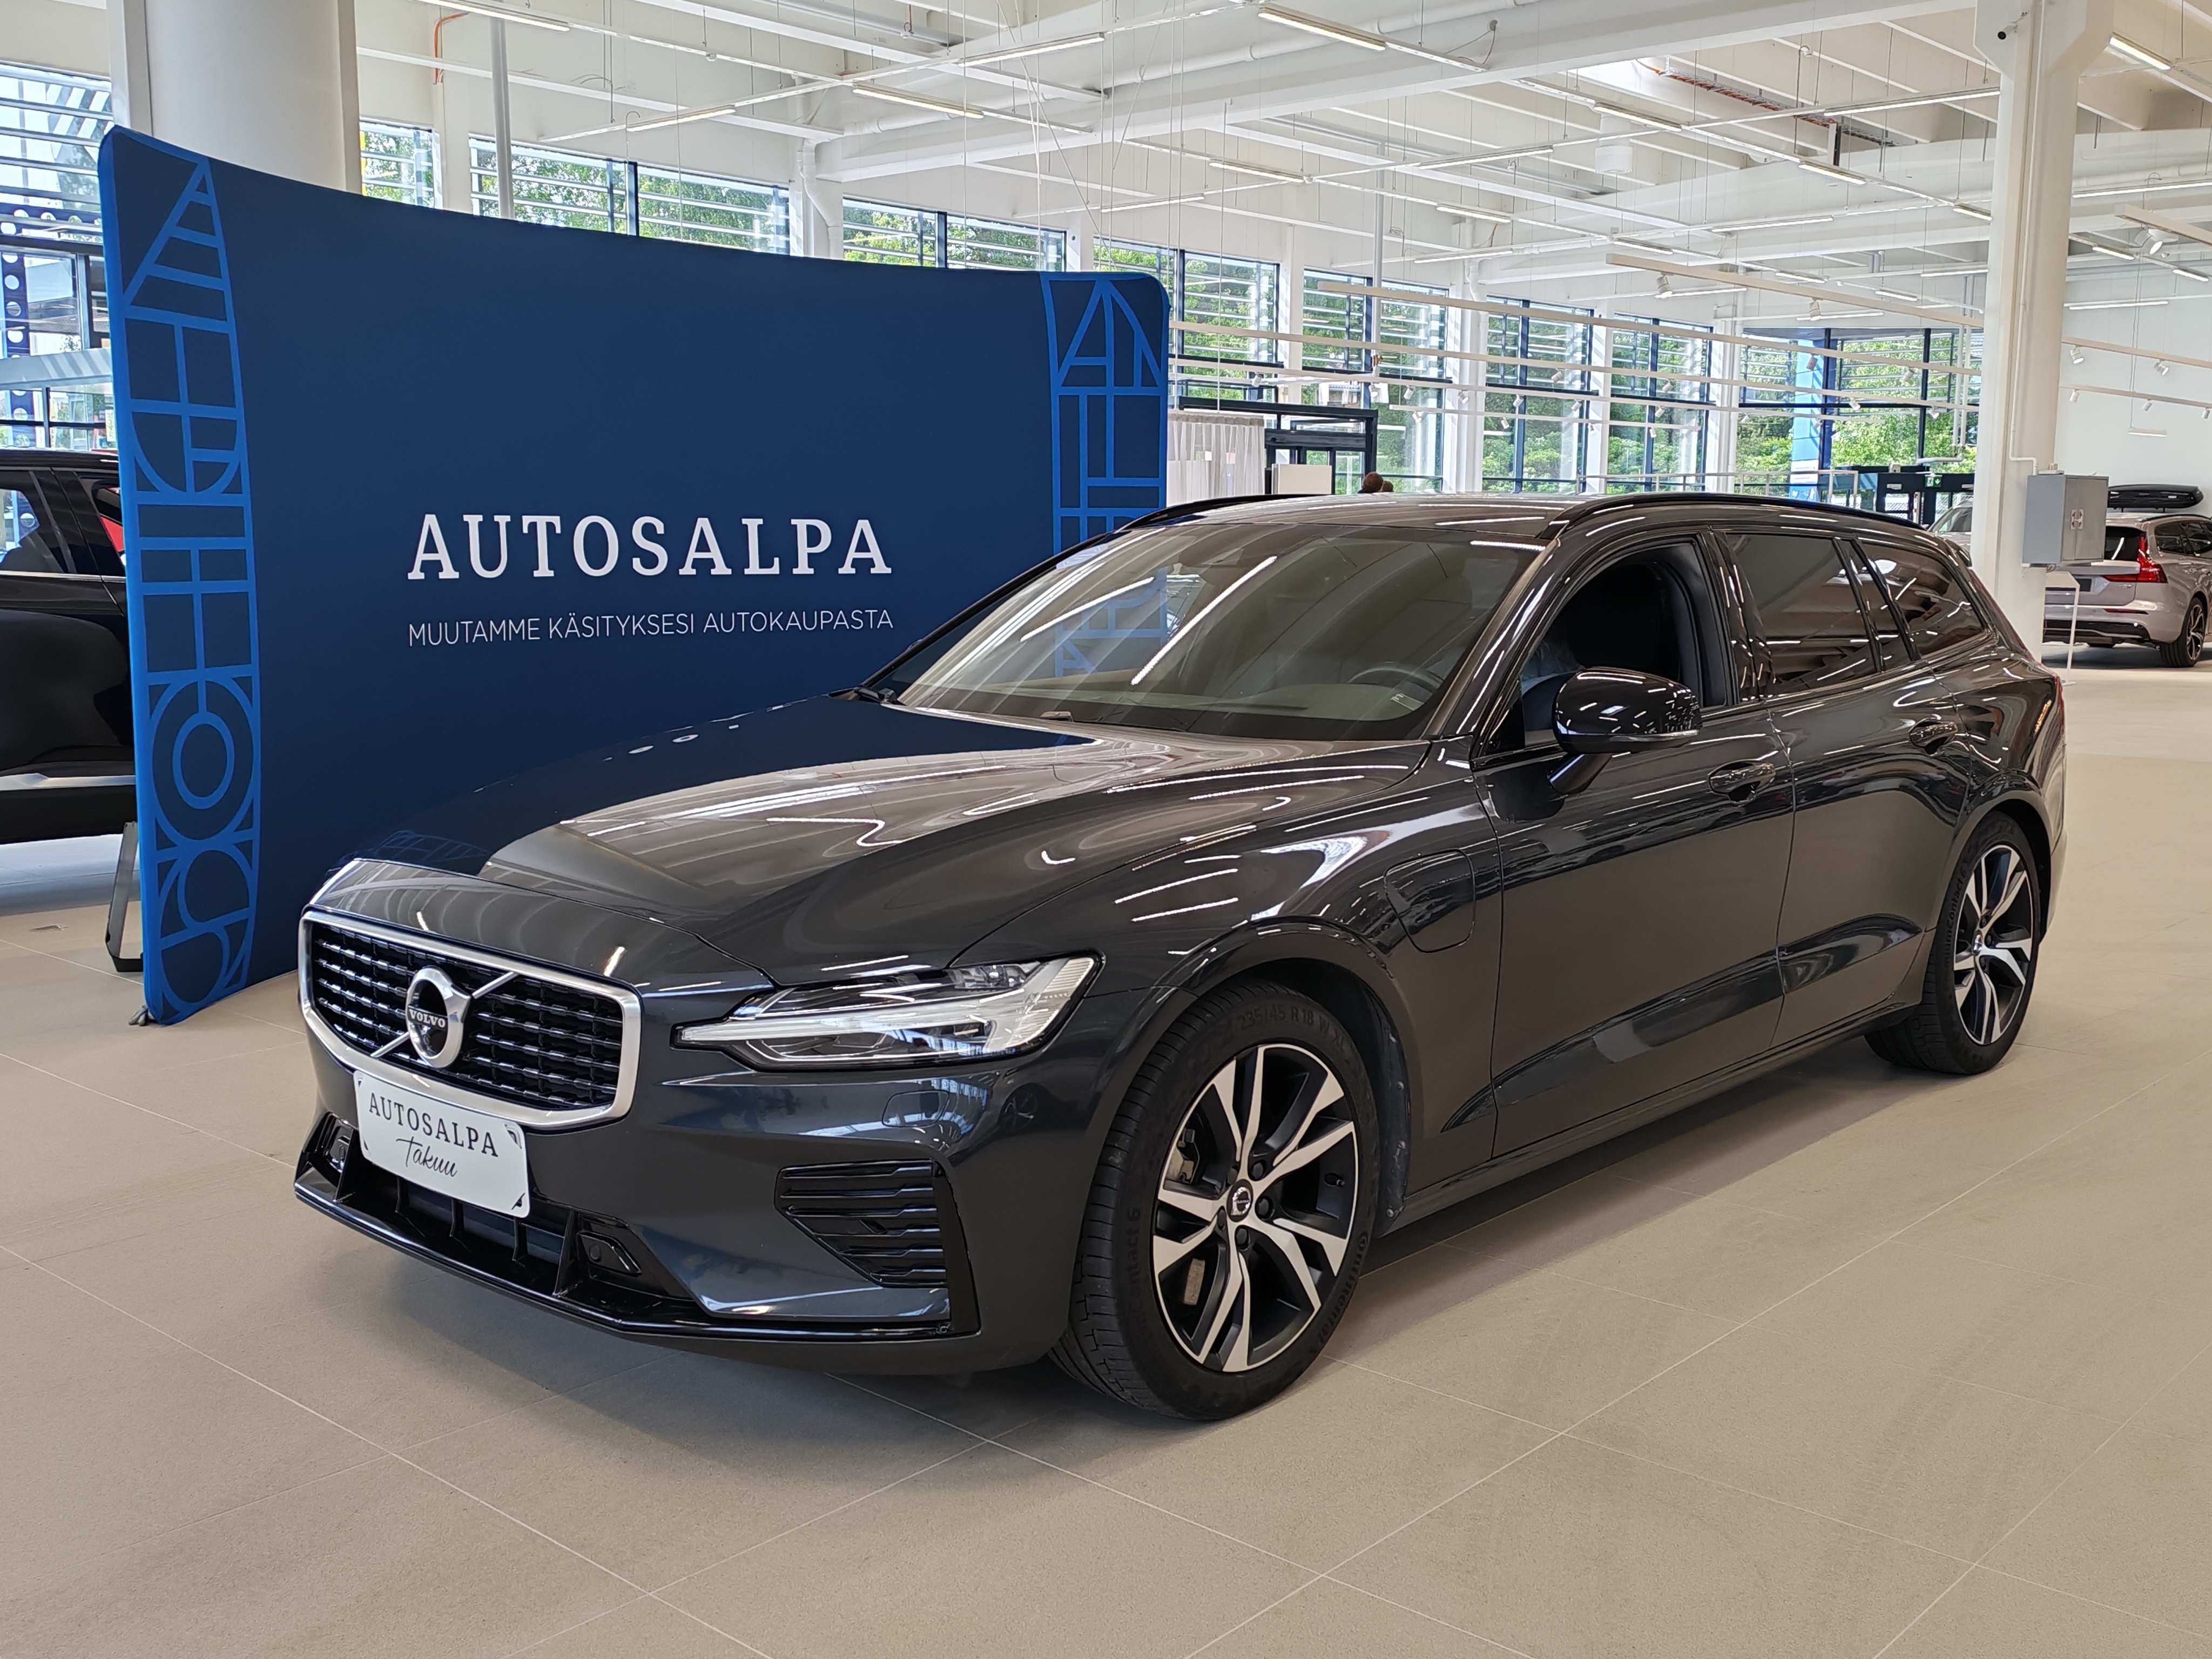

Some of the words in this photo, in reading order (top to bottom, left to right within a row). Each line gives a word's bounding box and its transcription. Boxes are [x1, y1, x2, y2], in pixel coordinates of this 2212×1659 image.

[408, 514, 892, 579] AUTOSALPA
[409, 618, 541, 646] MUUTAMME
[549, 612, 694, 639] KÄSITYKSESI
[703, 609, 893, 633] AUTOKAUPASTA
[409, 1009, 446, 1028] VOLVO
[369, 1092, 498, 1157] AUTOSALPA
[396, 1136, 457, 1177] Takuu
